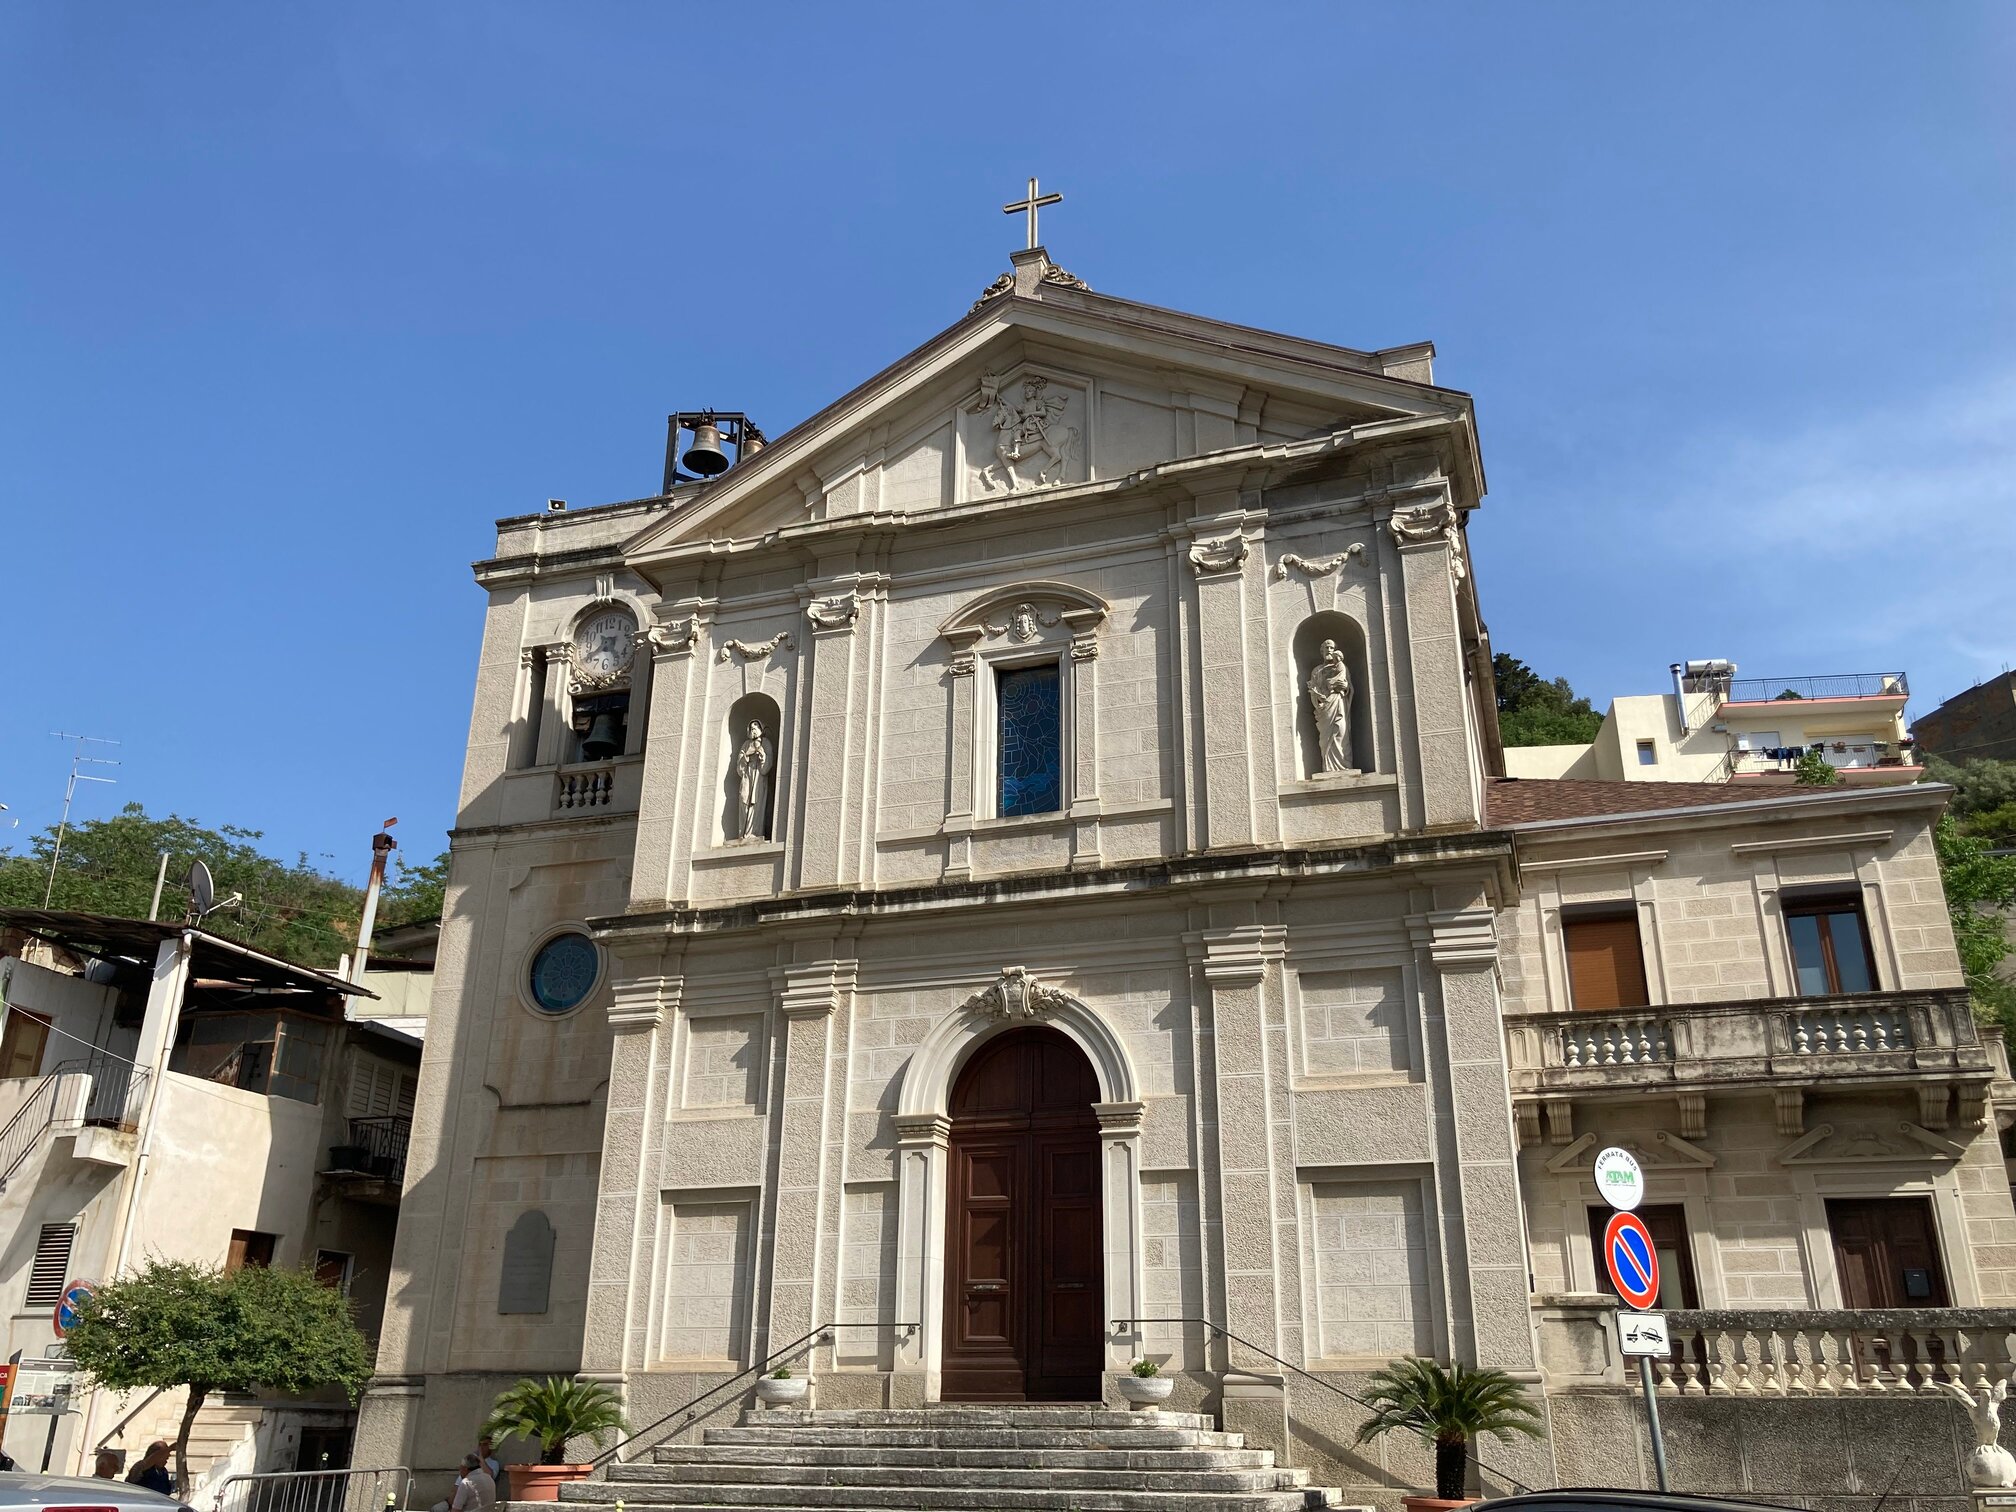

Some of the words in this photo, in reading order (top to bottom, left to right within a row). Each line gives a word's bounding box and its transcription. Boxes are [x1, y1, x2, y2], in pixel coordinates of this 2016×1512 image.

[596, 622, 603, 634] 11
[605, 618, 616, 630] 12
[586, 631, 596, 642] 10
[624, 624, 630, 637] 2
[586, 642, 592, 653] 9
[620, 646, 628, 658] 4
[593, 658, 600, 669] 7
[601, 658, 610, 670] 6
[1597, 1151, 1624, 1170] FERMATA
[1625, 1156, 1638, 1171] BUS
